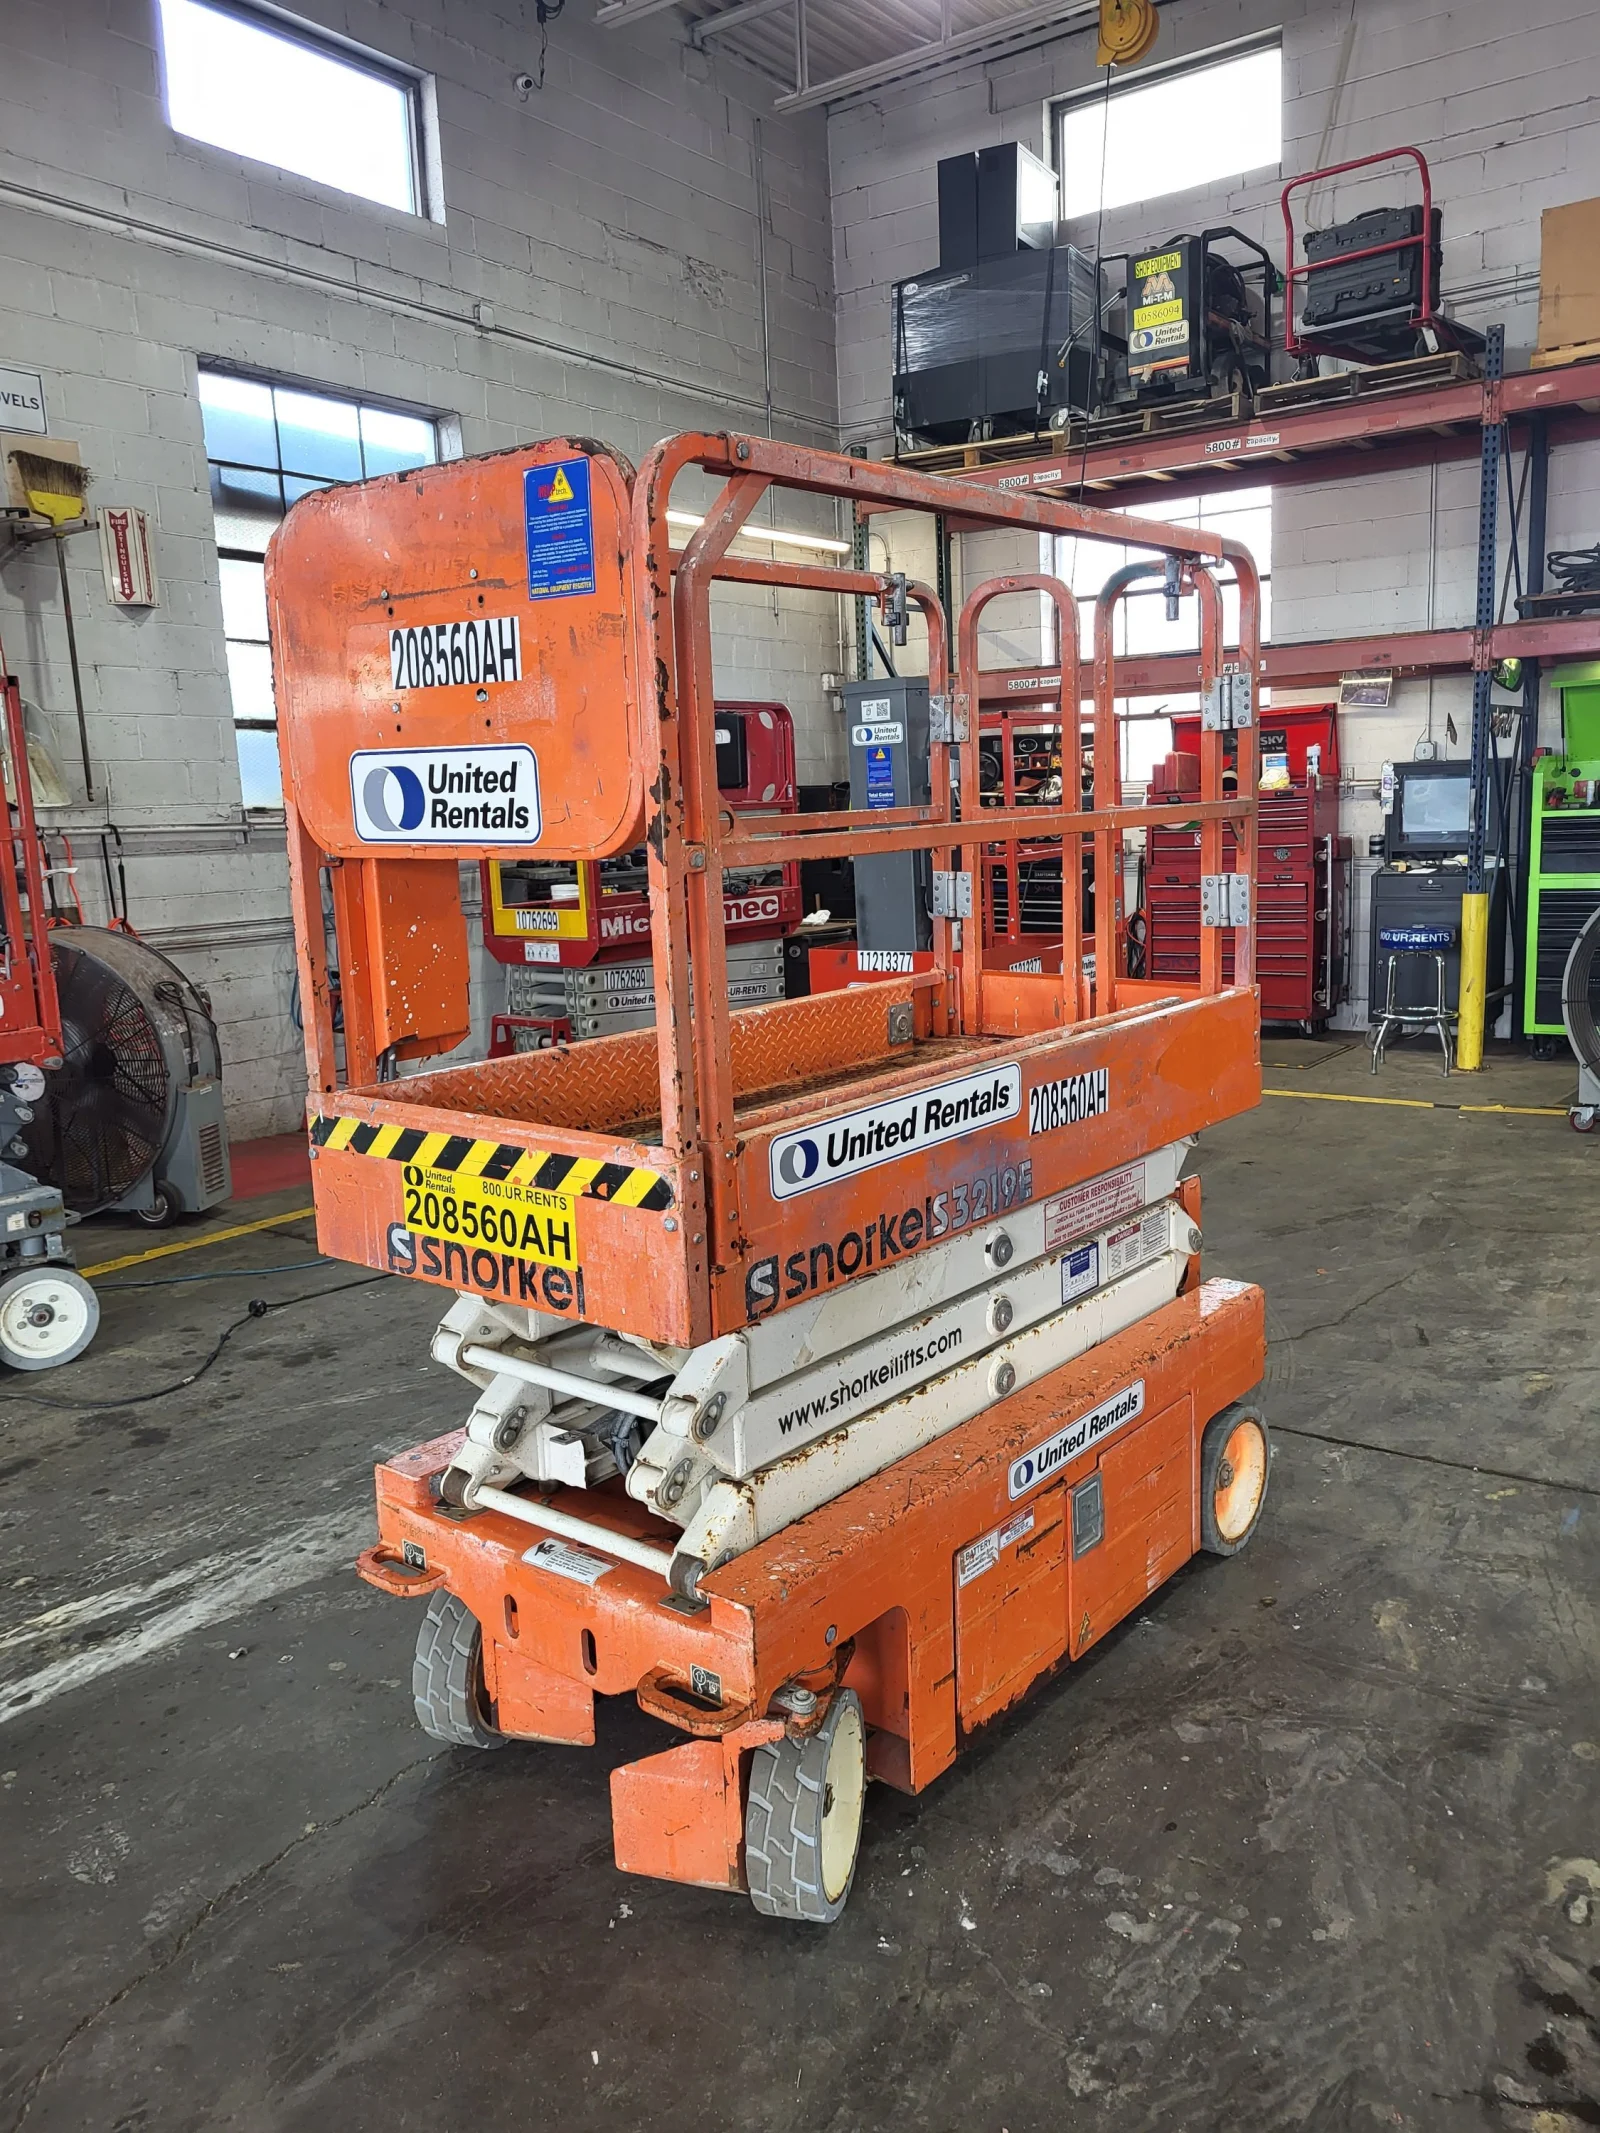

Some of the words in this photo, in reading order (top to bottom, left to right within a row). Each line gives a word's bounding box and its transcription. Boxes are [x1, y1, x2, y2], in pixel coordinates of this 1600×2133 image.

[1136, 262, 1150, 278] SHOP
[1151, 253, 1181, 272] EQUIPMENT
[1143, 291, 1173, 305] Mi-T-M
[1137, 305, 1180, 324] 10586094
[1155, 324, 1183, 337] United
[1155, 333, 1185, 345] Rentals
[0, 391, 39, 410] VELS
[1206, 440, 1239, 453] 5800#
[1247, 436, 1278, 445] capacity
[999, 475, 1028, 488] 5800#
[1034, 472, 1059, 481] capacity
[117, 526, 130, 594] EXTINGUISHER
[391, 617, 517, 690] 208560AH
[1009, 680, 1037, 690] 5800#
[874, 726, 898, 734] United
[874, 733, 900, 741] Rentals
[1260, 735, 1285, 746] SKY
[428, 761, 518, 794] United
[431, 798, 529, 829] Rentals
[517, 911, 558, 930] 10762699
[724, 899, 778, 921] mec
[601, 915, 649, 938] Mic
[859, 951, 913, 972] 11213377
[605, 969, 646, 990] 10762699
[728, 984, 767, 996] -UR-RENTS
[621, 995, 647, 1006] United
[1031, 1068, 1107, 1135] 208560AH
[827, 1106, 917, 1168] United
[923, 1079, 1010, 1134] Rentals
[425, 1169, 453, 1183] United
[425, 1181, 456, 1194] Rentals
[482, 1181, 567, 1211] 800.UR.RENTS
[1059, 1190, 1090, 1212] CUSTOMER
[1091, 1171, 1133, 1197] RESPONSIBILITY
[406, 1189, 571, 1261] 208560AH
[786, 1196, 934, 1301] snorkel
[421, 1235, 586, 1315] snorkel
[1037, 1423, 1086, 1474] United
[1089, 1392, 1138, 1439] Rentals
[965, 1537, 992, 1561] BATTERY
